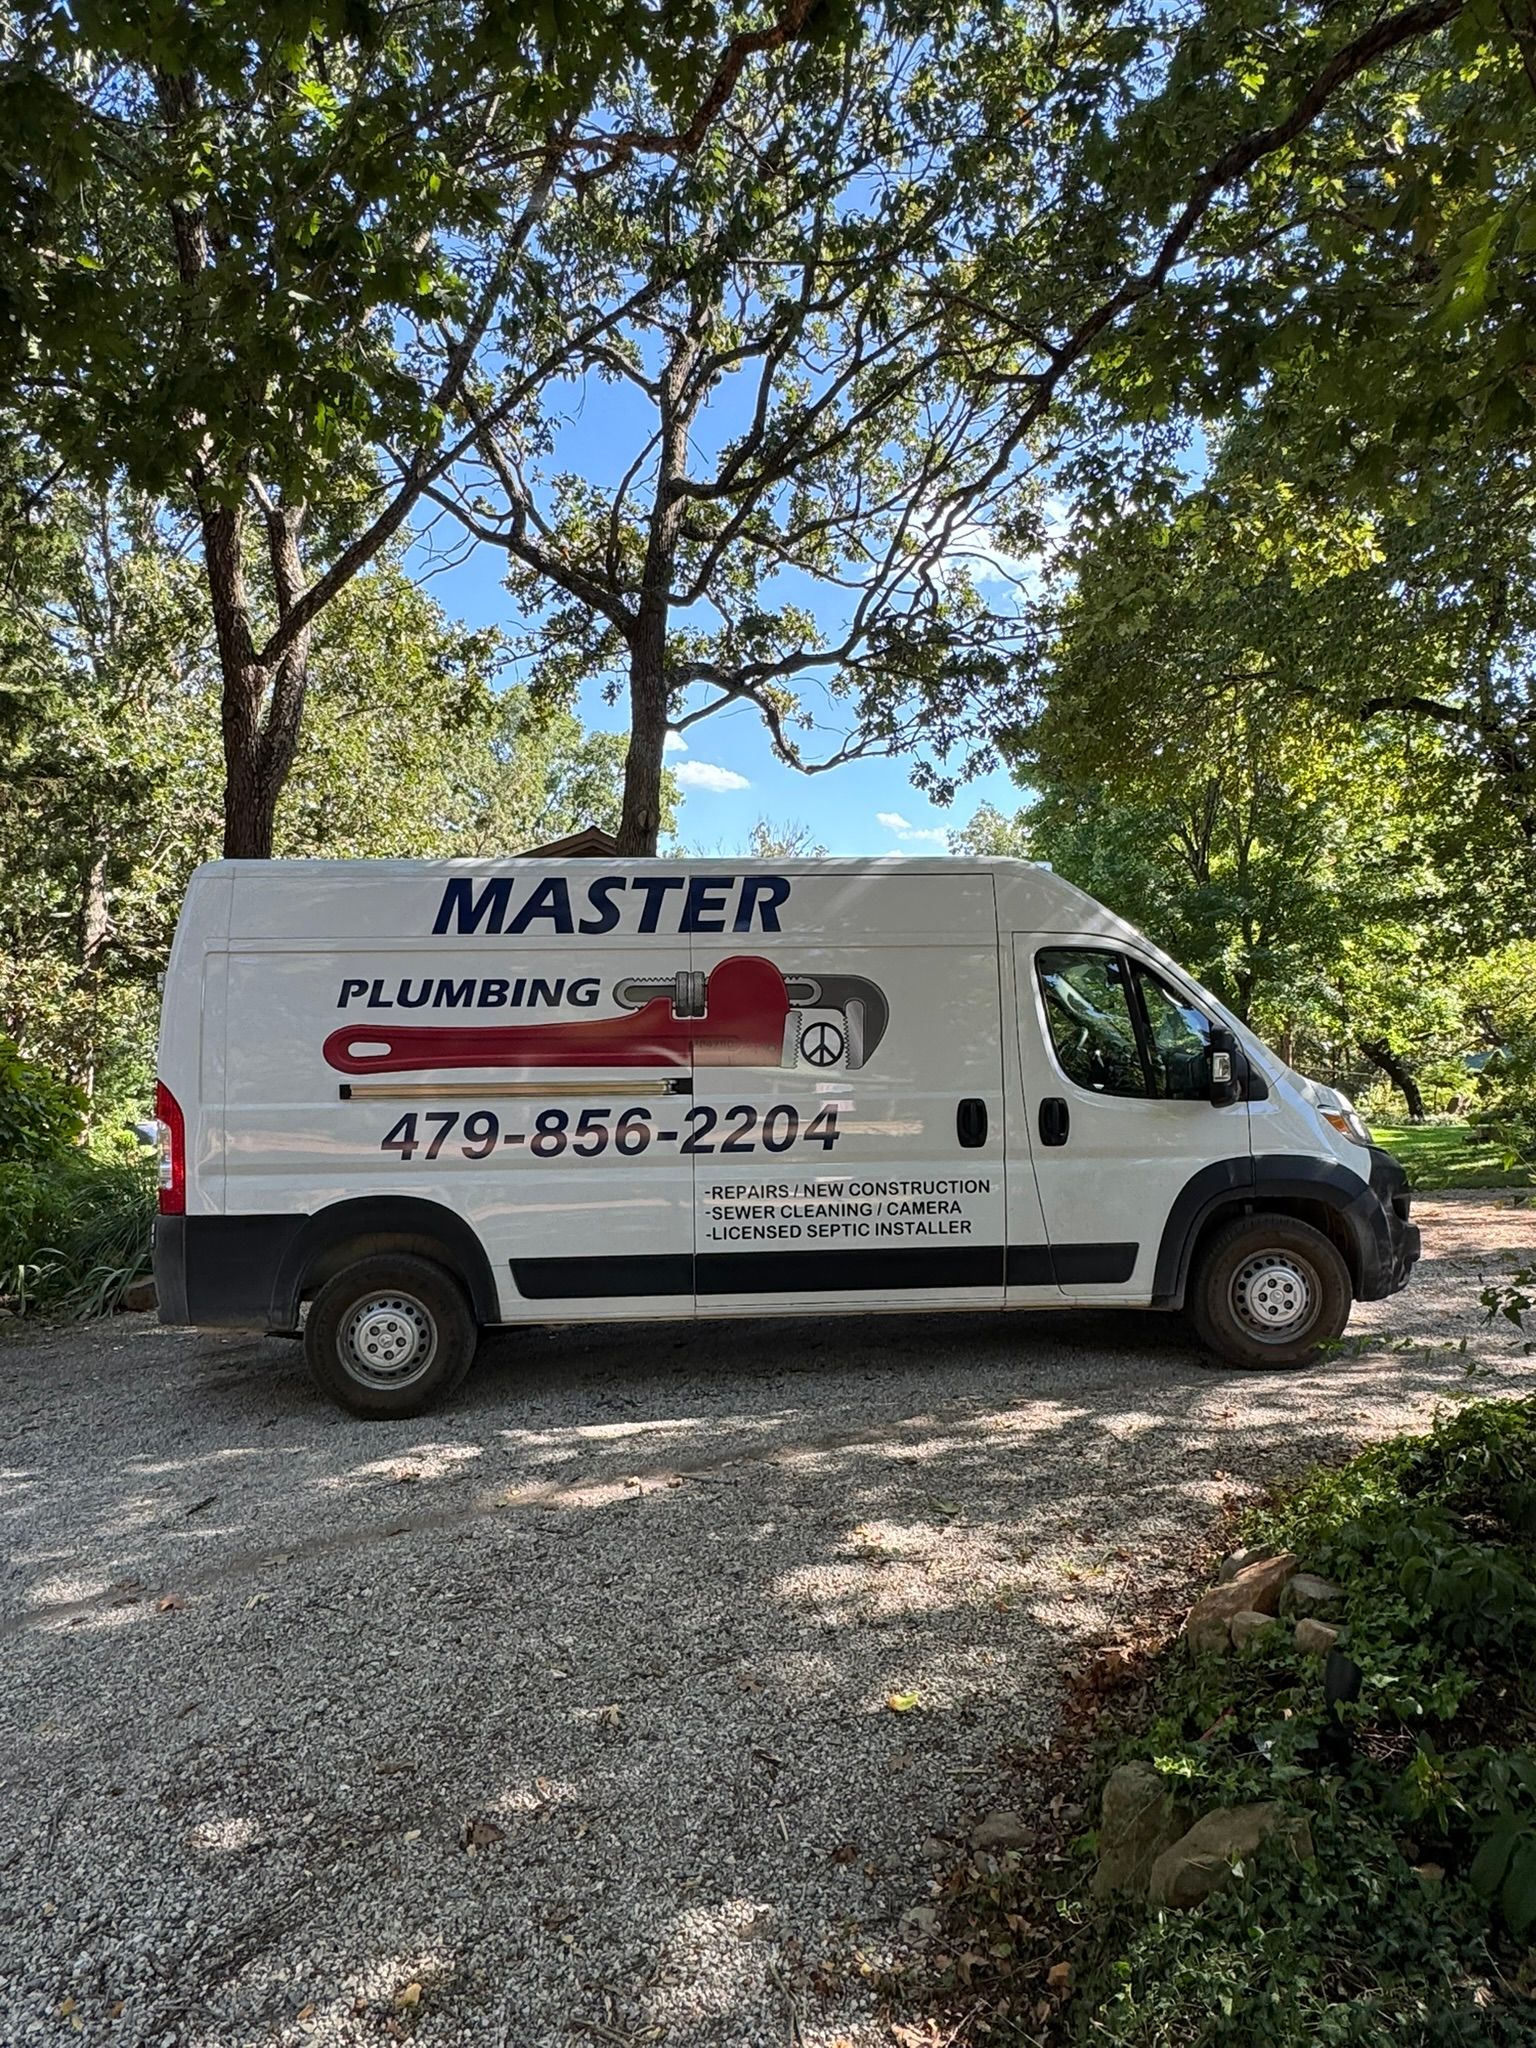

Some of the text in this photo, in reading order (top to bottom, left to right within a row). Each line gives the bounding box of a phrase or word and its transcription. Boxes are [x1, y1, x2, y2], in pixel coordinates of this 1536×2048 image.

[431, 877, 791, 935] MASTER
[337, 978, 600, 1009] PLUMBING
[381, 1104, 841, 1161] 479-856-2204
[803, 1183, 844, 1198] NEW
[849, 1179, 991, 1196] CONSTRUCTION
[780, 1203, 873, 1219] CLEANING
[886, 1200, 962, 1216] CAMERA
[806, 1222, 870, 1238] SEPTIC
[875, 1220, 972, 1236] INSTALLER
